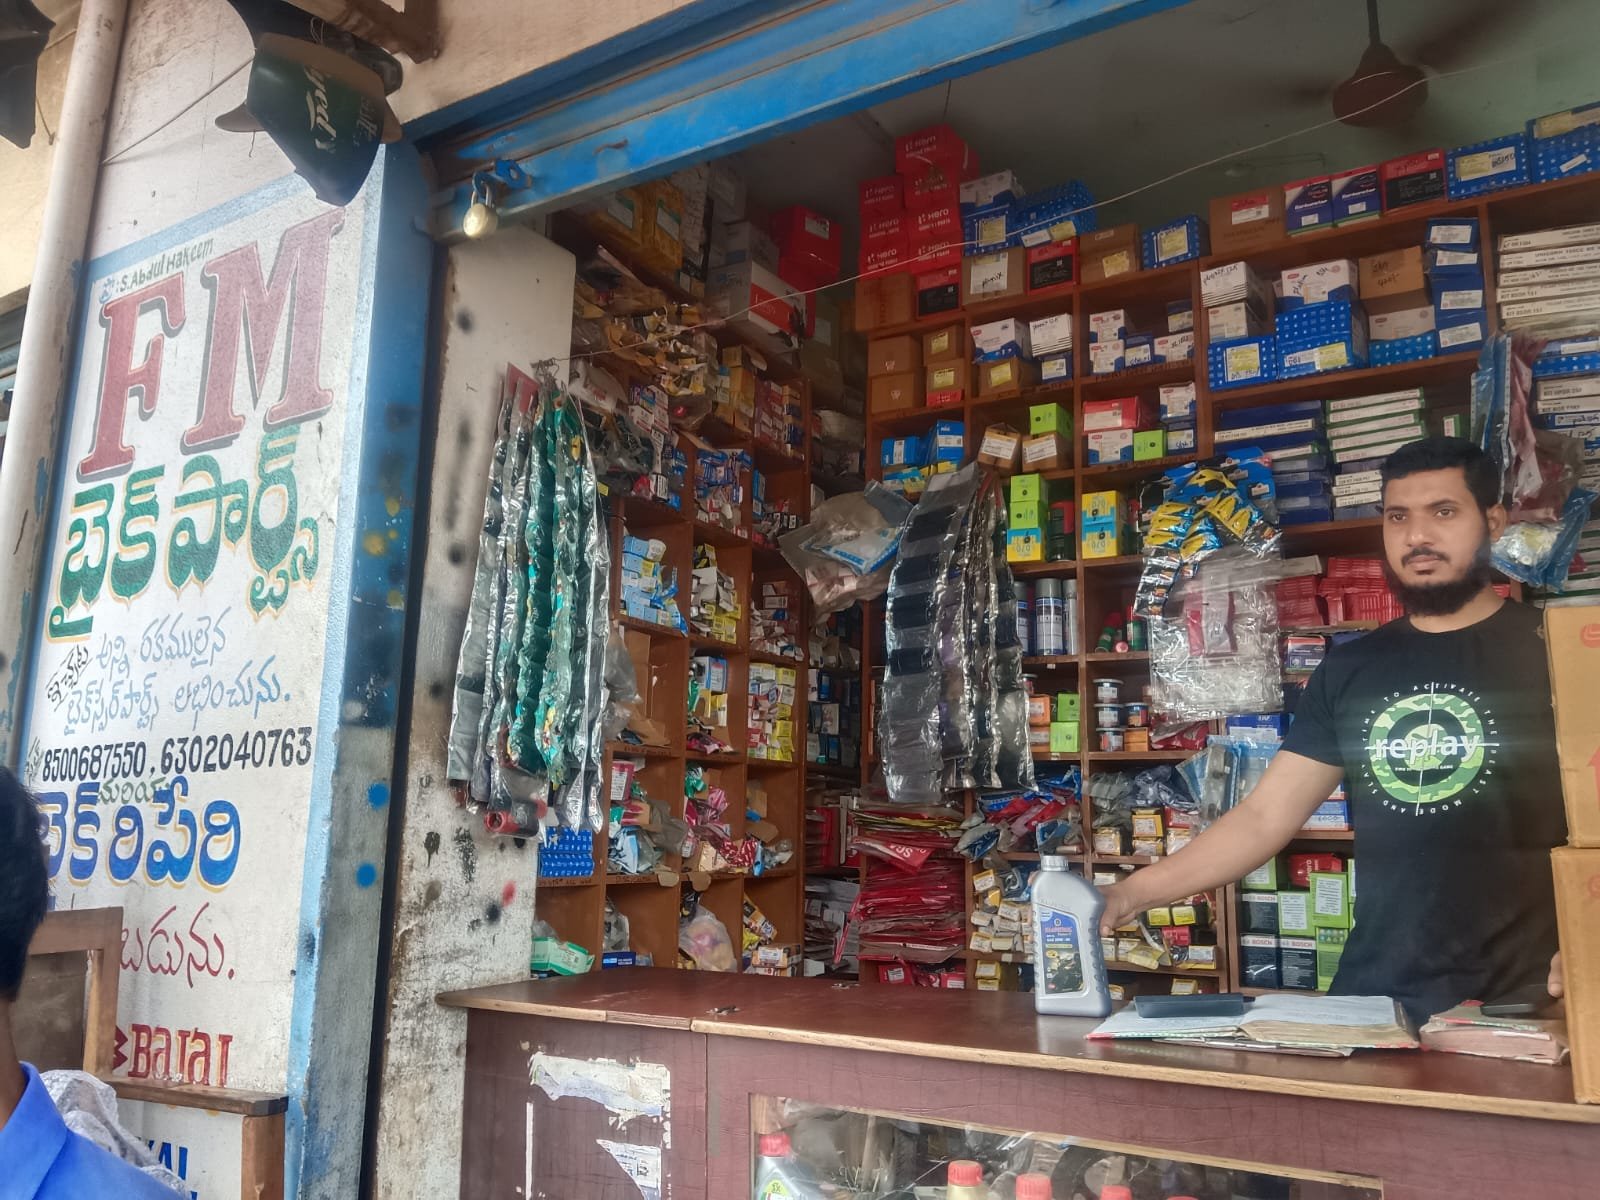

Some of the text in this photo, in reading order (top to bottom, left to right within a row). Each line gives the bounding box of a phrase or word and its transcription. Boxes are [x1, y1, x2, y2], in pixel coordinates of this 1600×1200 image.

[76, 207, 347, 484] FM
[1383, 692, 1400, 702] TO
[1413, 682, 1481, 703] ACTIVATE
[161, 726, 312, 775] 6302040763
[1374, 729, 1481, 765] replay
[1383, 799, 1407, 813] AND
[1418, 799, 1462, 815] MODE
[1251, 938, 1273, 946] BOSCH
[1291, 940, 1313, 948] BOSCH
